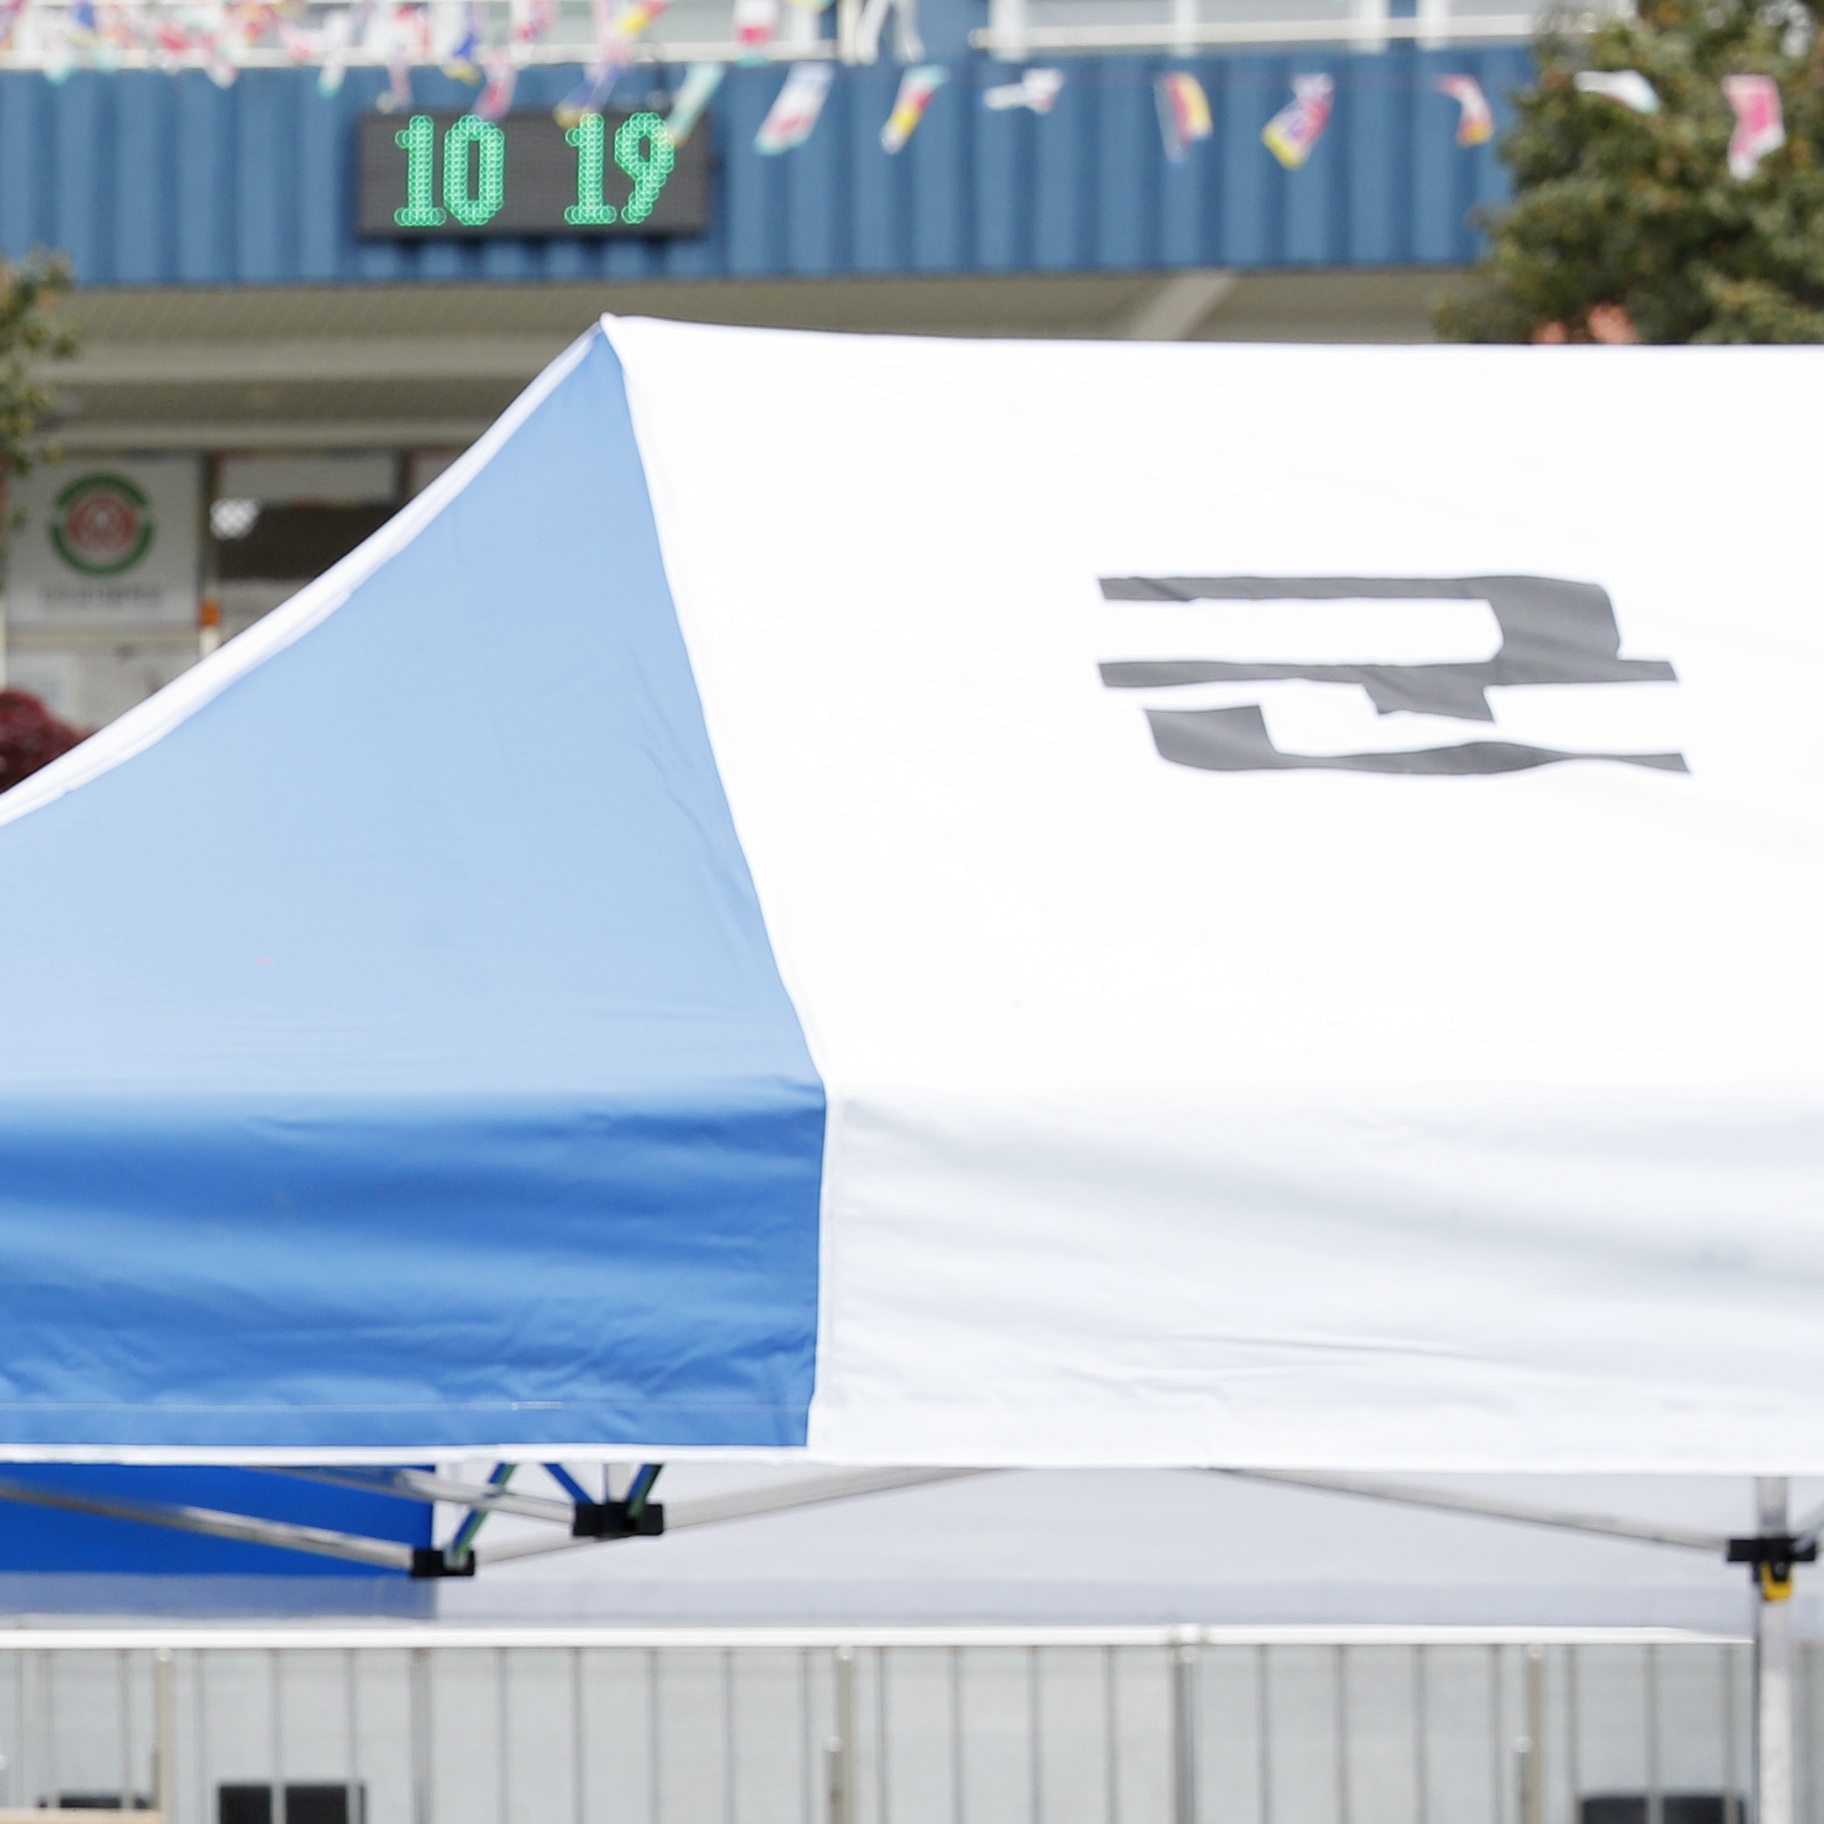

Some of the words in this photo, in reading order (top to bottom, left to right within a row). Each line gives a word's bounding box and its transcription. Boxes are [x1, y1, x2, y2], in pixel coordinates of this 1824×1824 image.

[394, 114, 506, 227] 10
[564, 111, 676, 225] 19
[1096, 574, 1692, 776] 군
